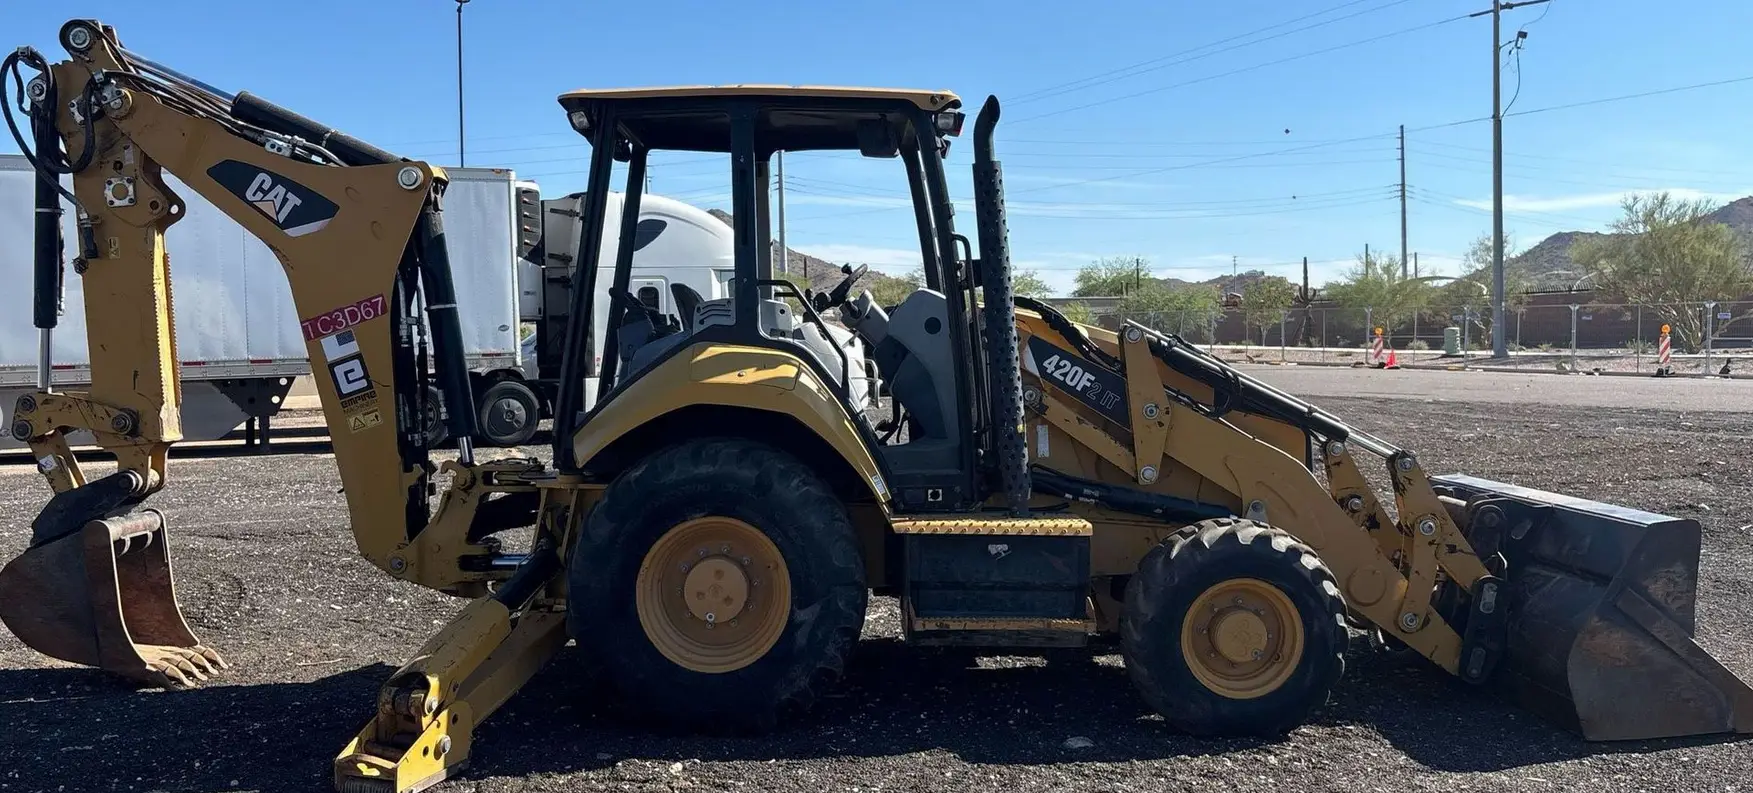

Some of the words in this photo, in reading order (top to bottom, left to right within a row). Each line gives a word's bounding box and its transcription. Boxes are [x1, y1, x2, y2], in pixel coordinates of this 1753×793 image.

[245, 172, 302, 224] CAT
[302, 296, 383, 339] TC3D67
[1100, 390, 1120, 410] IT
